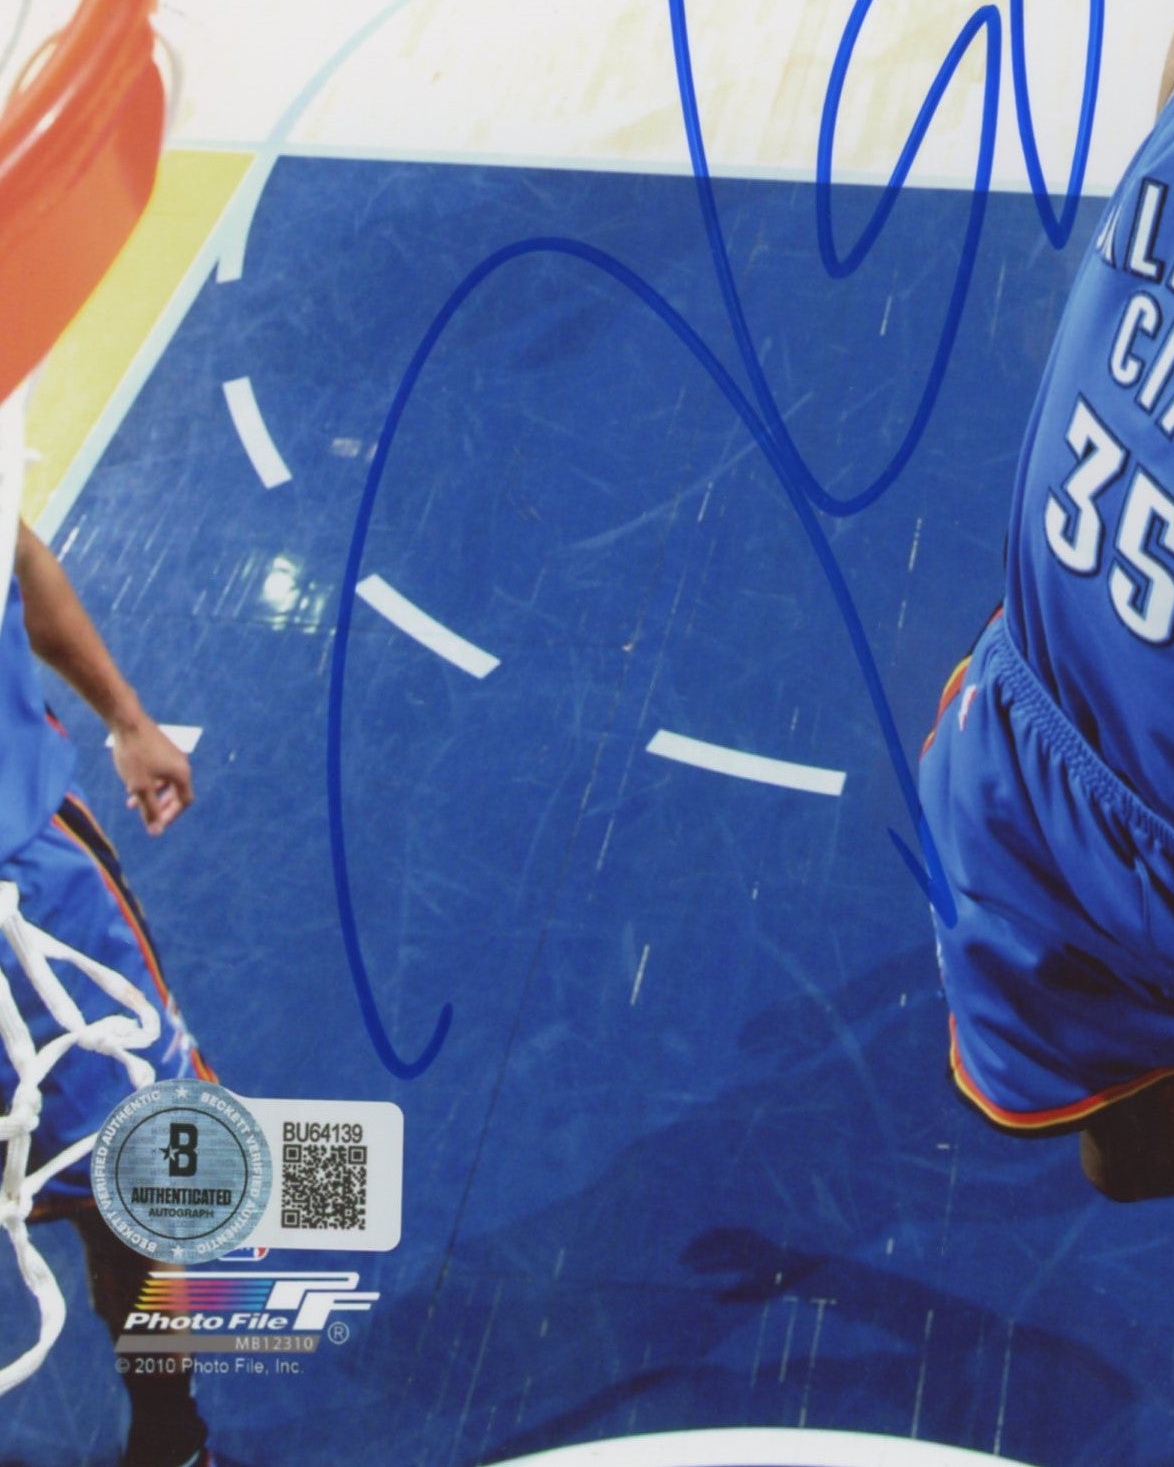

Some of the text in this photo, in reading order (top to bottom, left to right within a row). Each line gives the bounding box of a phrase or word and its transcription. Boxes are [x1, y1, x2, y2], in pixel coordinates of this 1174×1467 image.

[102, 1090, 162, 1146] AUTHENTIC
[200, 1092, 250, 1134] BECKETT
[282, 1121, 364, 1143] BU64139
[131, 1186, 232, 1206] AUTHENTICATED
[149, 1207, 214, 1219] AUTOGRAPH
[106, 1210, 158, 1253] BECKETT
